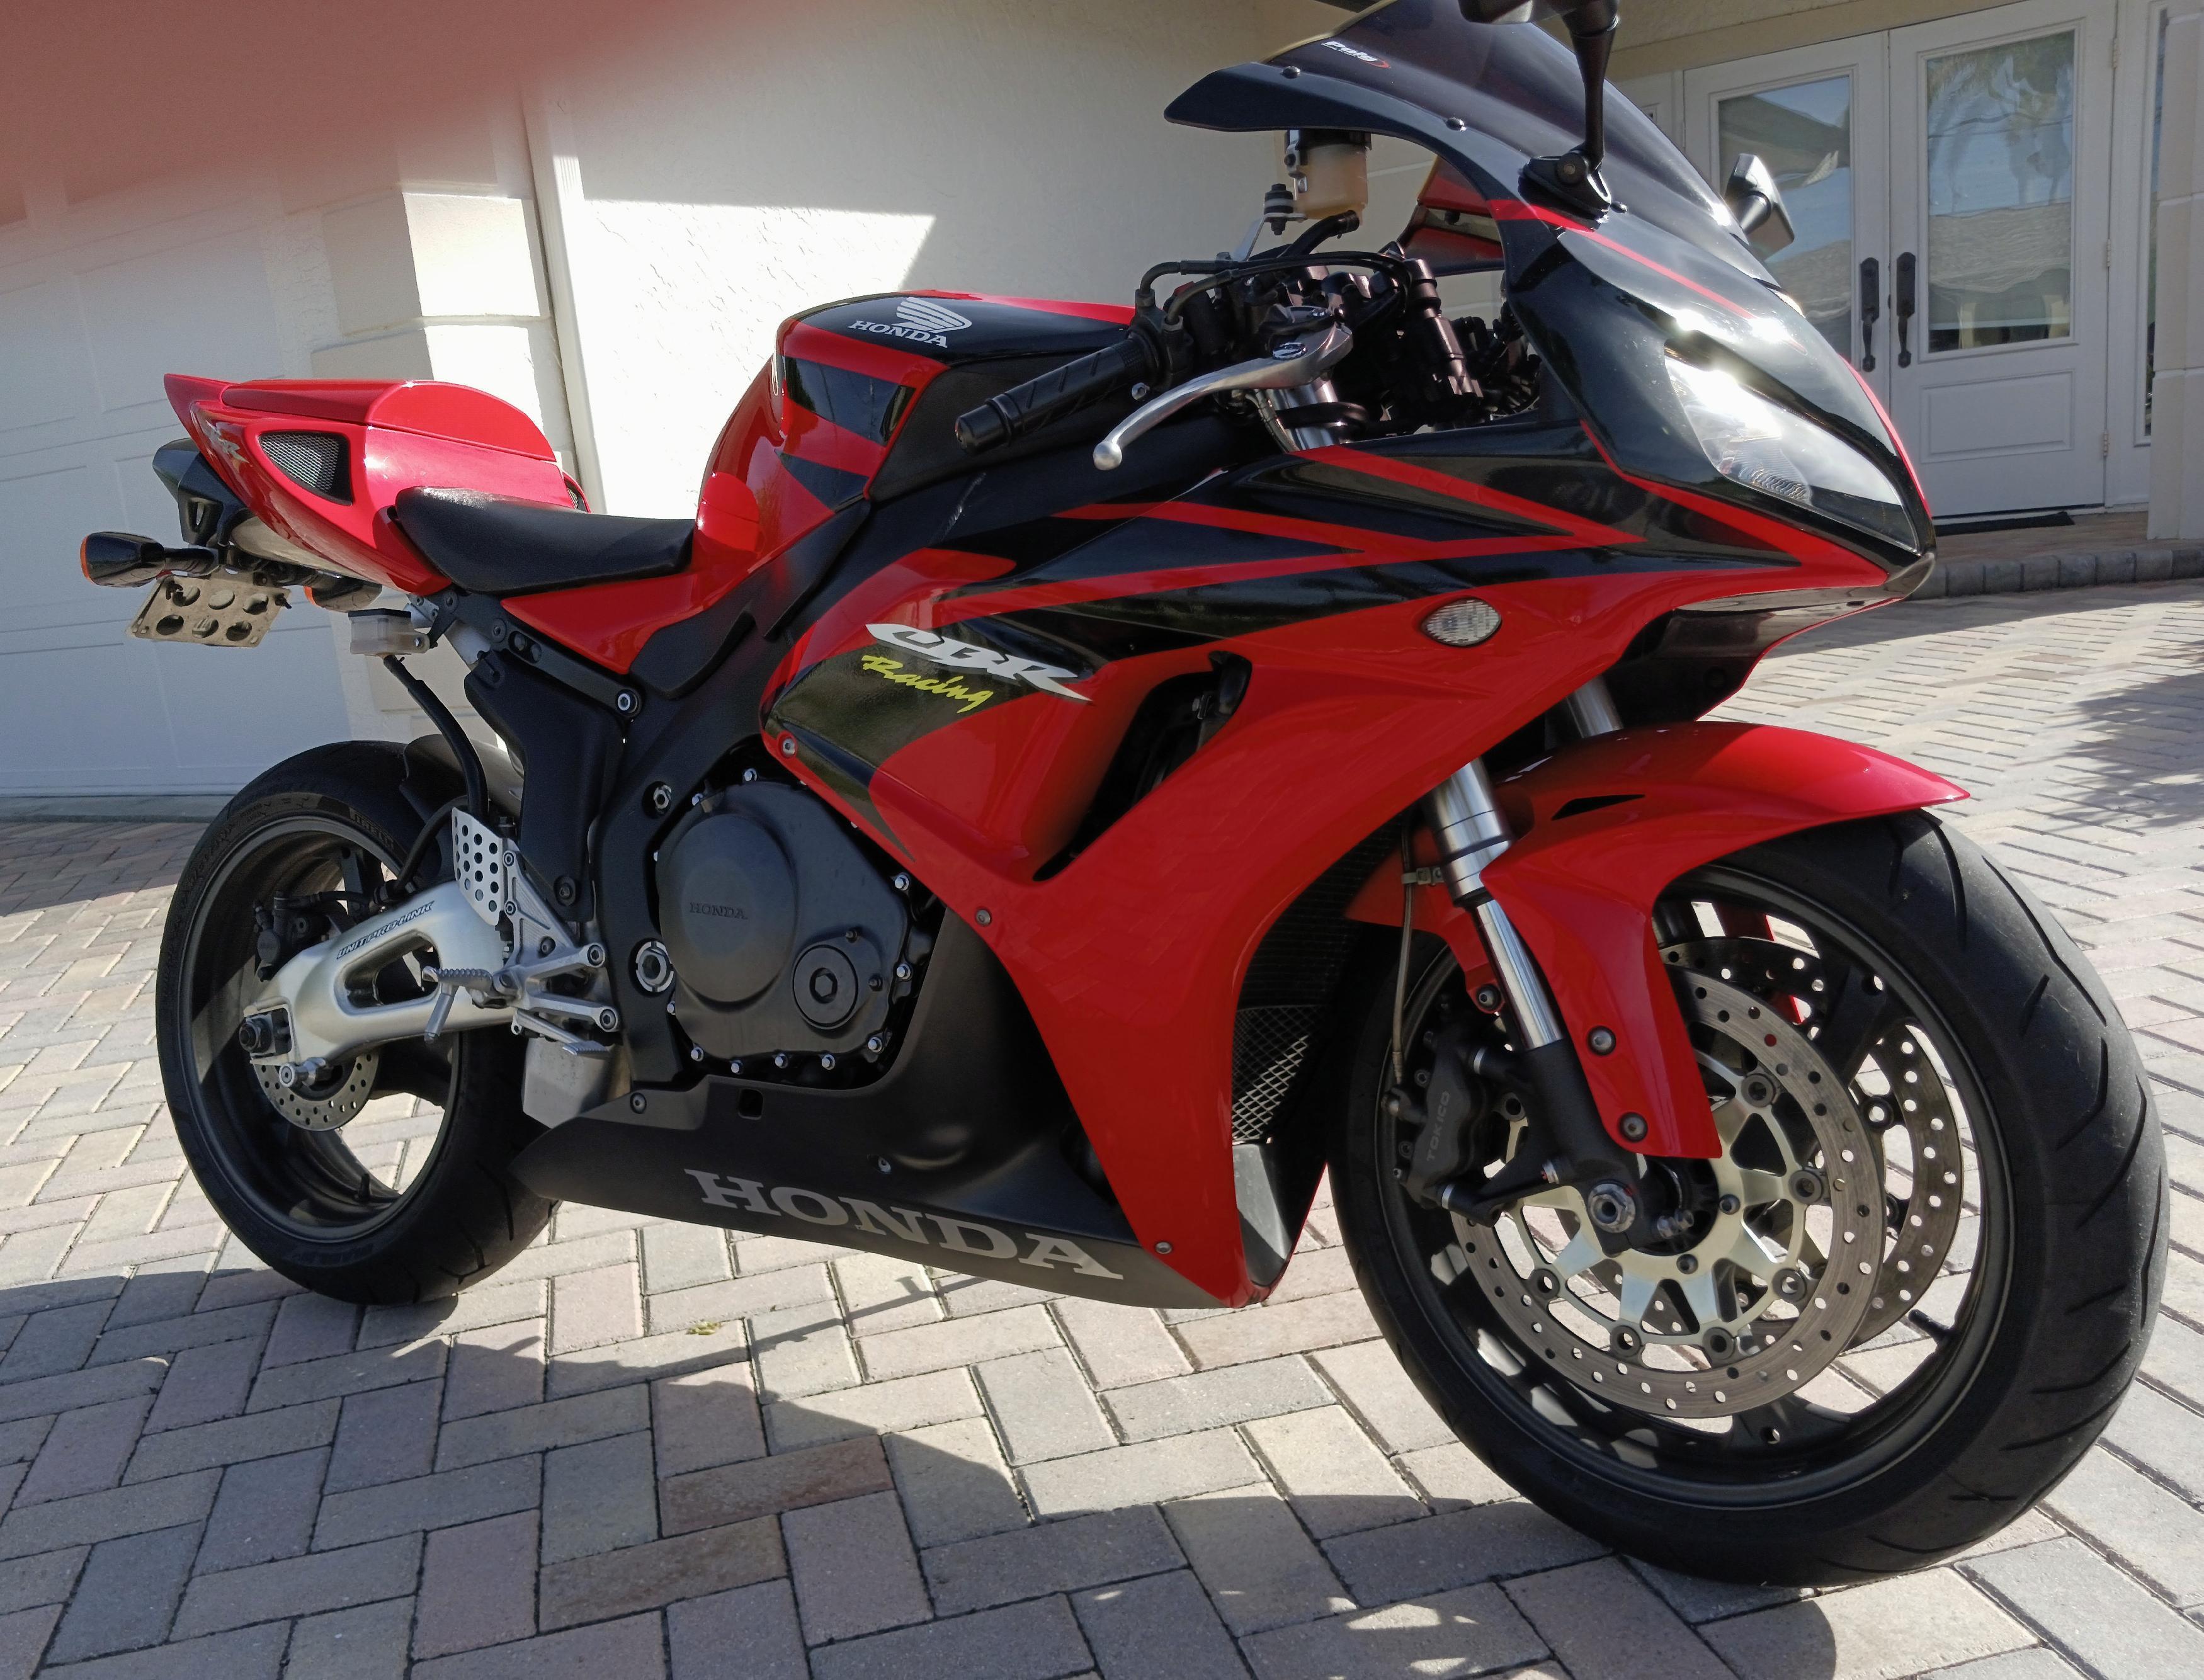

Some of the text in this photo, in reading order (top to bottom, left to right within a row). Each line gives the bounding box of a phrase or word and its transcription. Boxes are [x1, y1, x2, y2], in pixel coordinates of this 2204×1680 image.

[848, 320, 948, 348] HONDA
[861, 655, 994, 713] Racing
[865, 623, 1093, 702] CBR
[690, 902, 748, 919] HONDA
[1426, 1090, 1451, 1162] TOKICO
[684, 1169, 1123, 1280] HONDA
